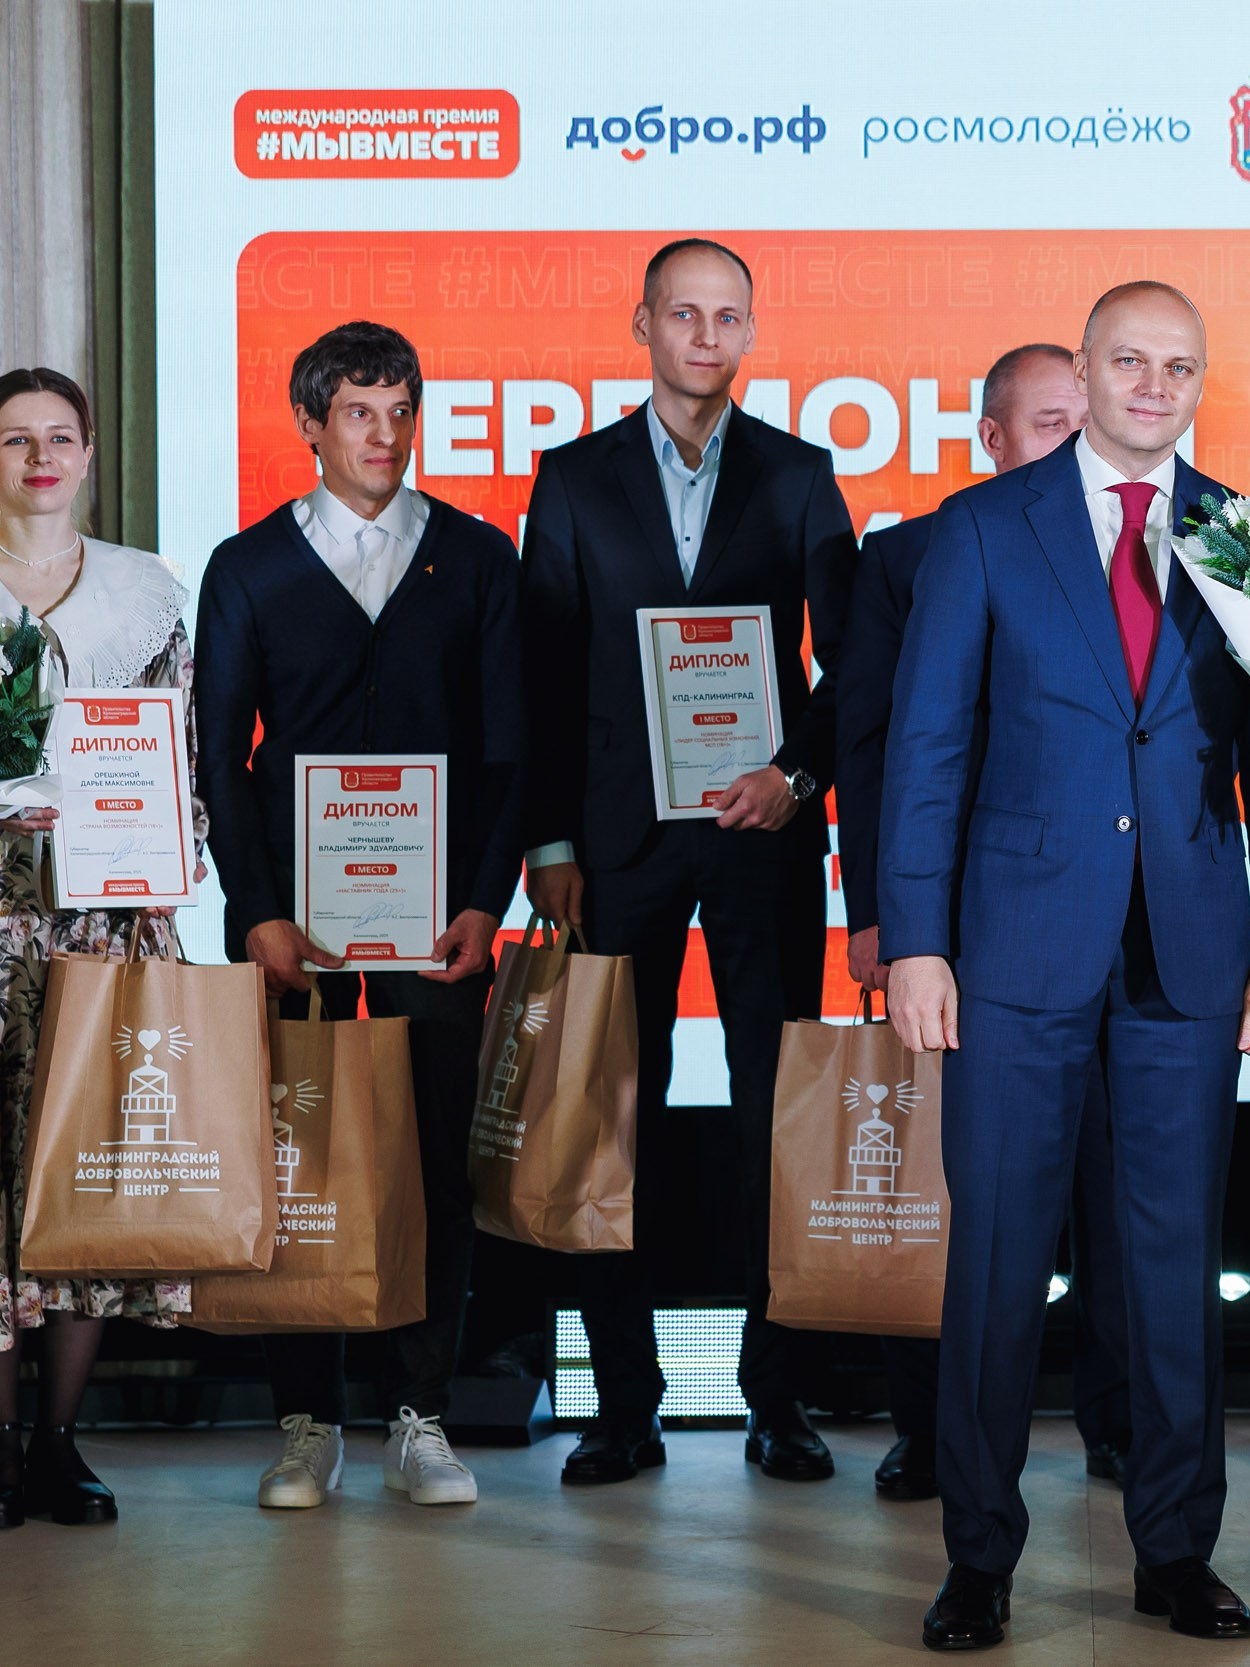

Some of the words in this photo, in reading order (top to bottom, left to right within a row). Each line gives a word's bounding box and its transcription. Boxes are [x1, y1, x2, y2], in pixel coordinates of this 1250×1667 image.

[255, 108, 419, 129] международная
[423, 108, 499, 129] премия
[566, 104, 827, 154] добро.рф
[863, 106, 1192, 159] росмолодёжь
[255, 131, 499, 160] #МЫВМЕСТЕ
[669, 652, 750, 672] ДИПЛОМ
[672, 692, 755, 703] КПД-КАЛИНИНГРАД
[704, 715, 731, 723] МЕСТО
[71, 737, 158, 754] ДИПЛОМ
[94, 770, 140, 778] ОРЕШКИНОЙ
[80, 780, 104, 788] ДАРЬЕ
[107, 801, 137, 809] МЕСТО
[323, 802, 418, 820] ДИПЛОМ
[318, 845, 368, 853] ВЛАДИМИРУ
[368, 845, 425, 853] ЭДУАРДОВИЧУ
[357, 866, 390, 874] МЕСТО
[77, 1150, 220, 1164] КАЛИНИНГРАДСКИЙ
[75, 1166, 220, 1180] ДОБРОВОЛЬЧЕСКИЙ
[123, 1184, 170, 1197] ЦЕНТР
[810, 1199, 941, 1215] КАЛИНИНГРАДСКИЙ
[807, 1215, 941, 1231] ДОБРОВОЛЬЧЕСКИЙ
[851, 1233, 893, 1246] ЦЕНТР
